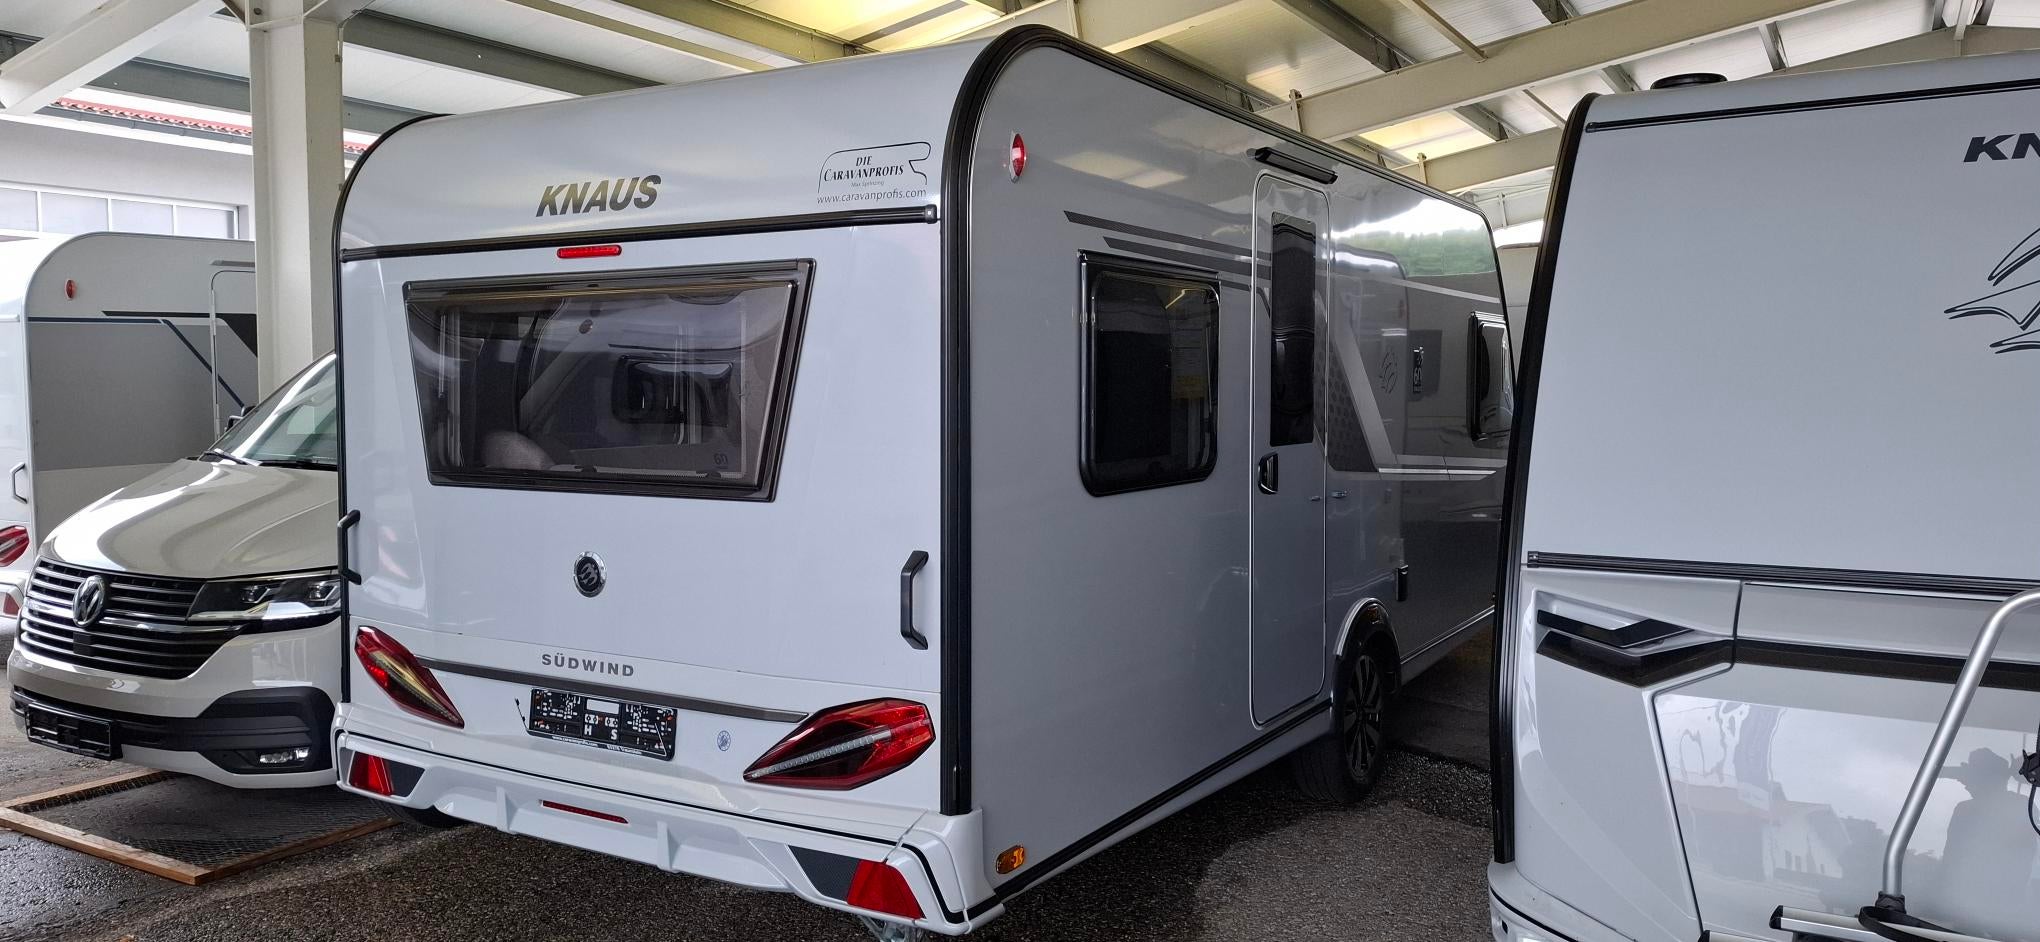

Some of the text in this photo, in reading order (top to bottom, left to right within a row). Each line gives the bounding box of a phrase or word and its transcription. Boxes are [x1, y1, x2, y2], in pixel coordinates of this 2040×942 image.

[856, 155, 872, 167] DIE
[536, 174, 661, 218] KNAUS
[817, 188, 927, 204] www.caravanprofis.com
[541, 652, 635, 677] SÜDWIND
